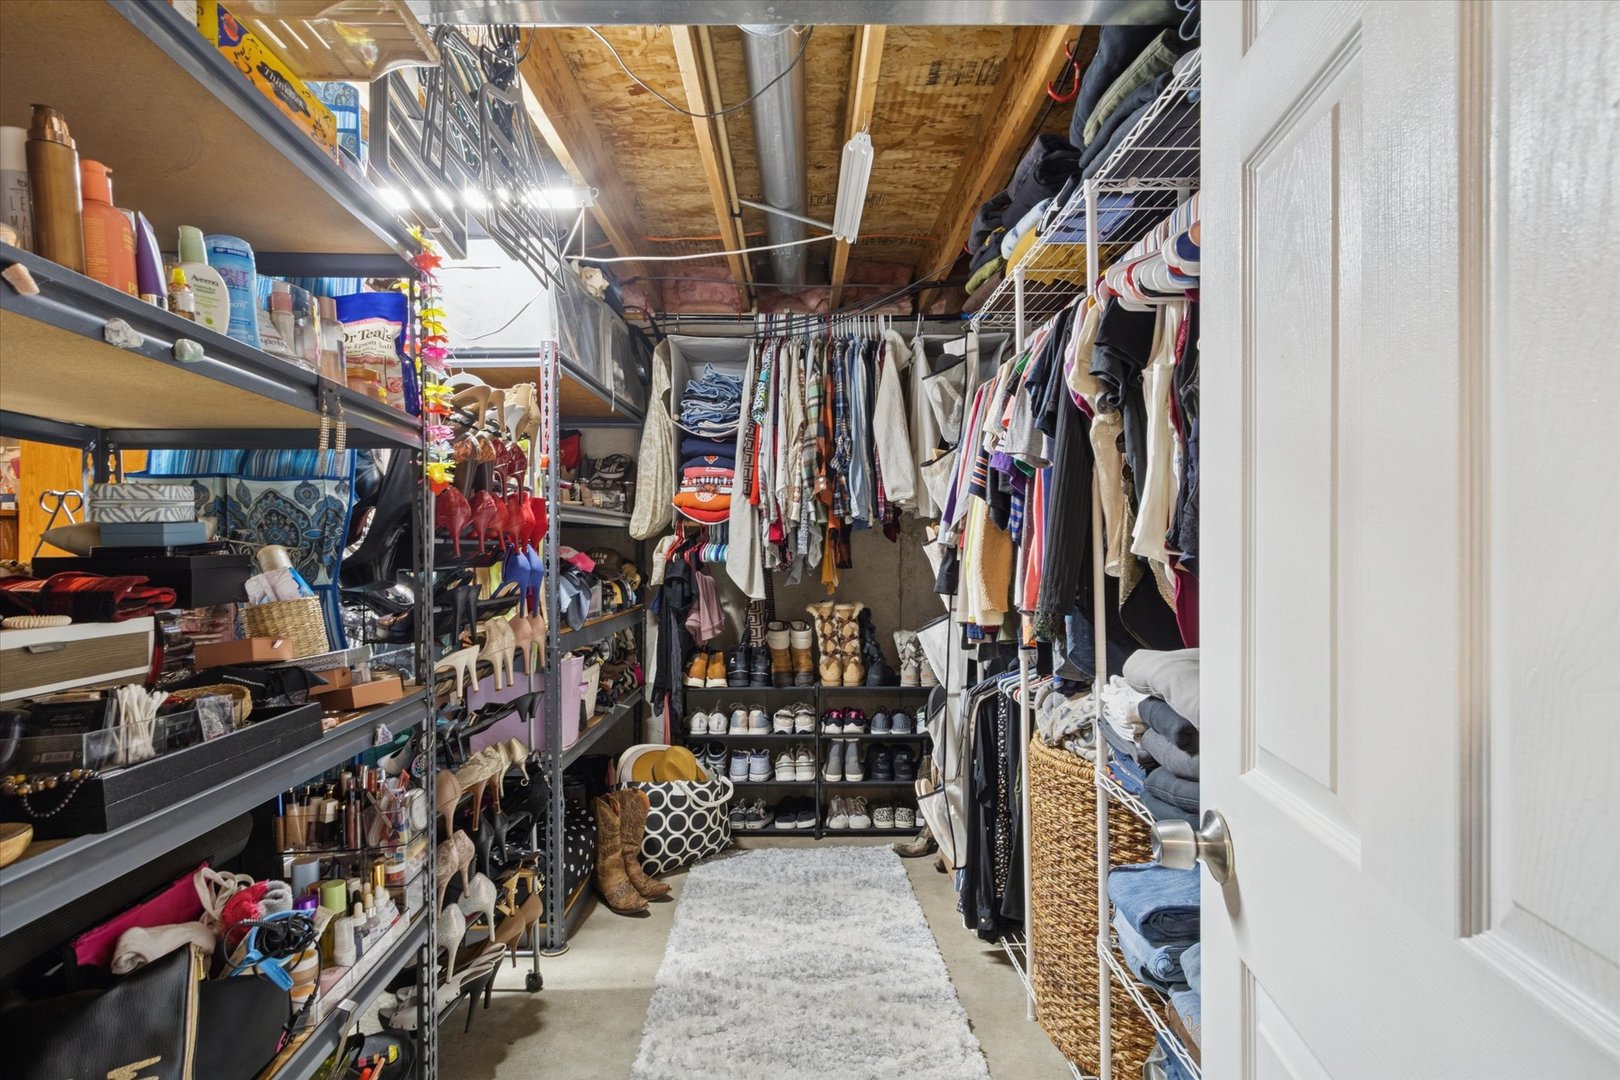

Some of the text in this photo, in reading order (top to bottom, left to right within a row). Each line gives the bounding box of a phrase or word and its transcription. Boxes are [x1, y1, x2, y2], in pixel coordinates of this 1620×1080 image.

[191, 274, 219, 287] Aveeno
[357, 326, 392, 343] Teal's
[354, 340, 377, 349] Epsom
[378, 341, 392, 350] Salt
